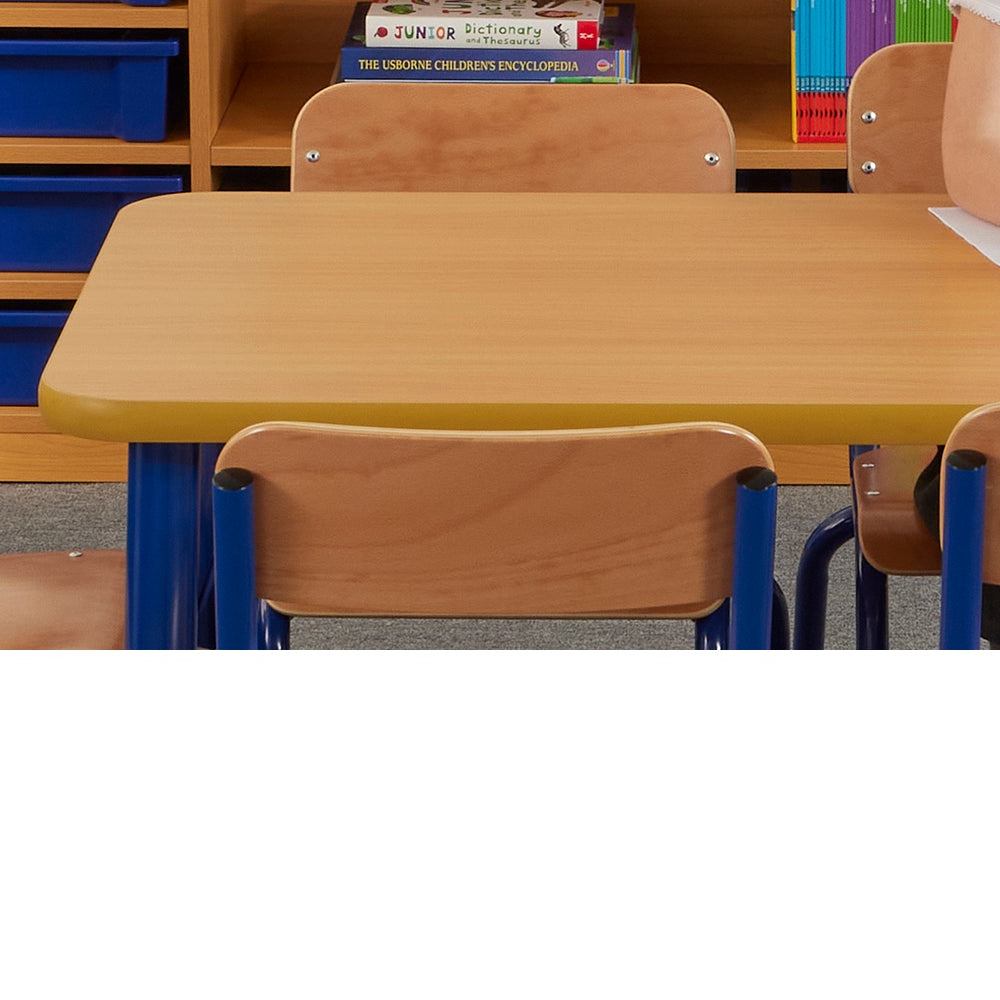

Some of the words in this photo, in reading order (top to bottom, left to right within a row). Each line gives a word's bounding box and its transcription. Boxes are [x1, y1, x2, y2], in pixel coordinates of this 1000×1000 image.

[394, 25, 455, 40] JUNIOR
[465, 23, 542, 38] Dictionary
[483, 35, 541, 46] Thesaurus
[358, 59, 379, 70] THE
[382, 59, 432, 71] USBORNE
[434, 59, 496, 71] CHILDREN'S
[498, 60, 579, 72] ENCYCLOPEDIA
